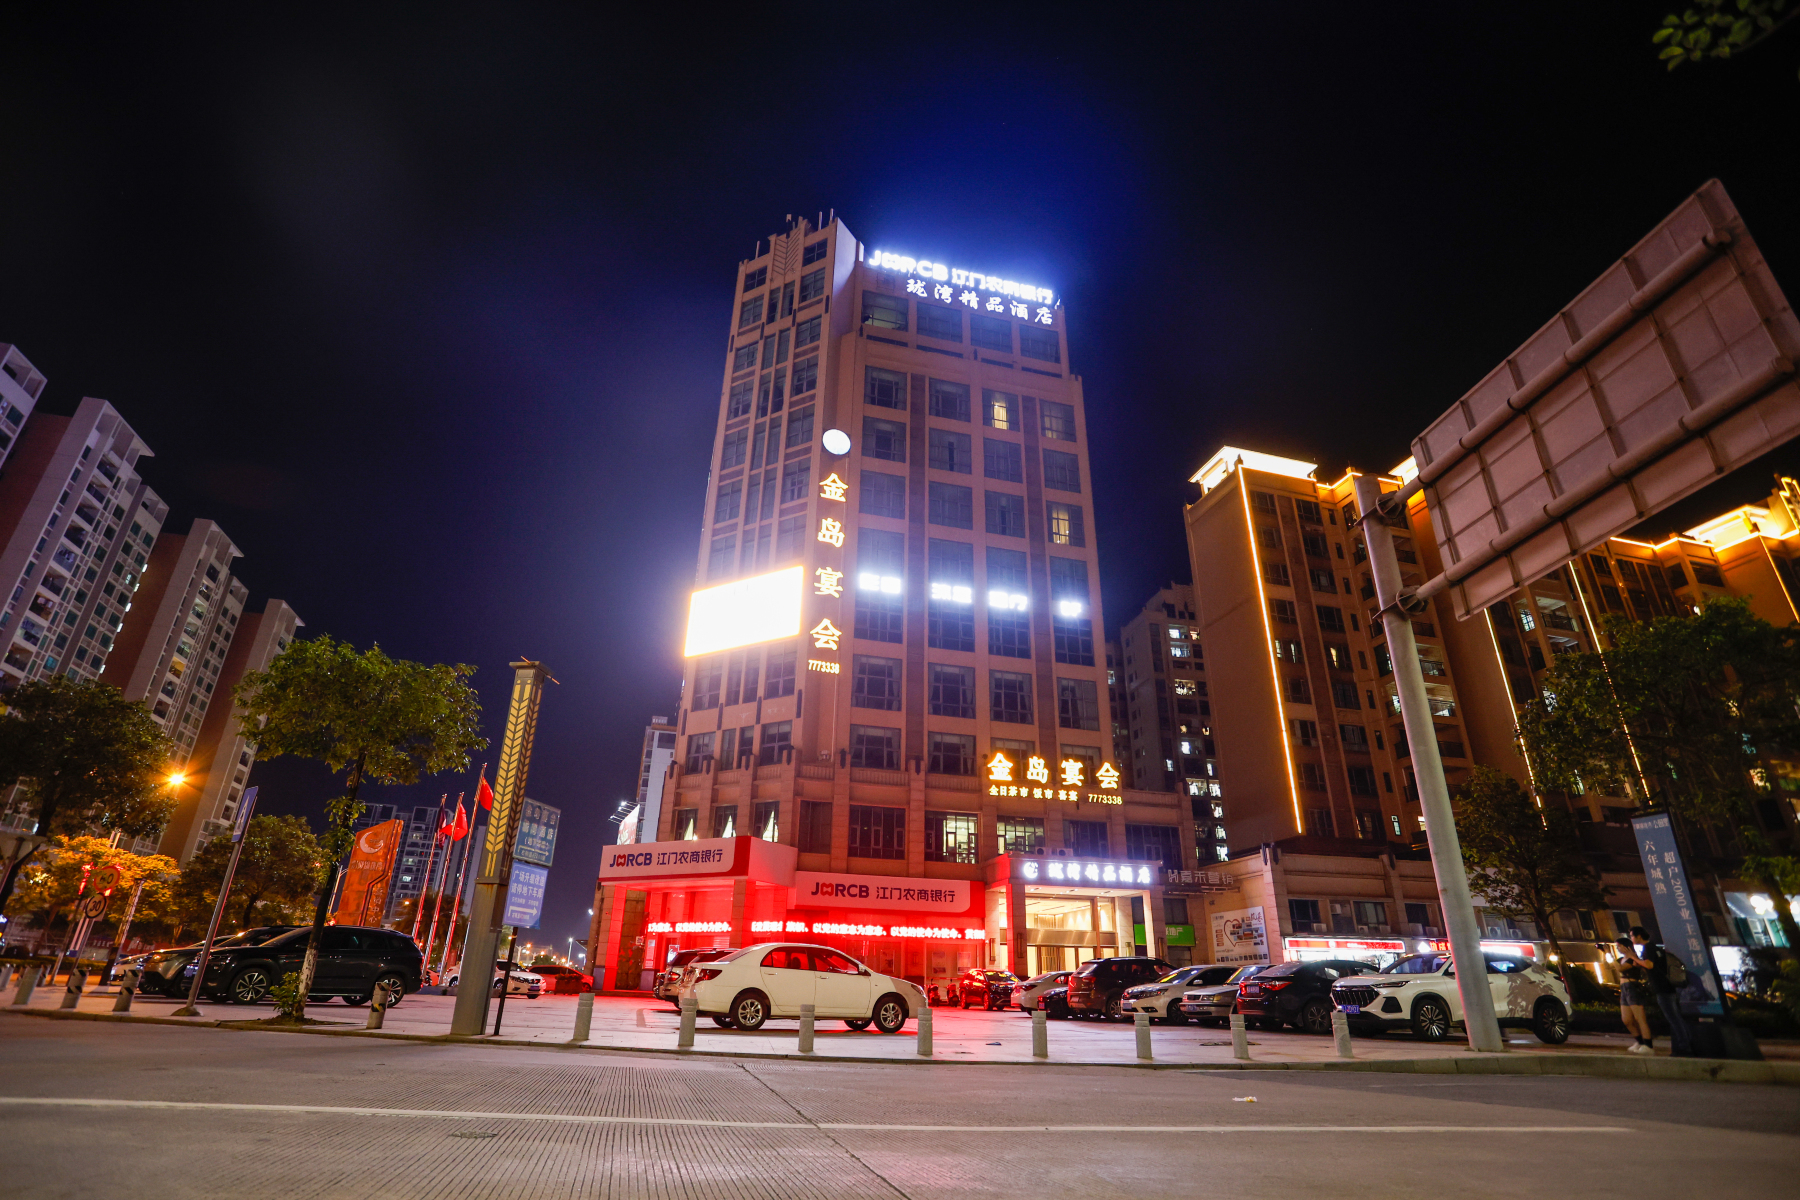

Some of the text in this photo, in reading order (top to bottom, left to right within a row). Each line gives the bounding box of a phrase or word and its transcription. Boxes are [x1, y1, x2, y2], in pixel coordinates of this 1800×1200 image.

[951, 268, 1053, 304] 江门农商银行
[810, 473, 849, 650] 金岛宴会
[808, 659, 840, 674] 7773338
[987, 752, 1120, 789] 金岛宴会
[1087, 793, 1122, 805] 7773338
[656, 849, 723, 866] 江门农商银行
[876, 886, 956, 903] 江门农商银行
[89, 900, 102, 912] 30
